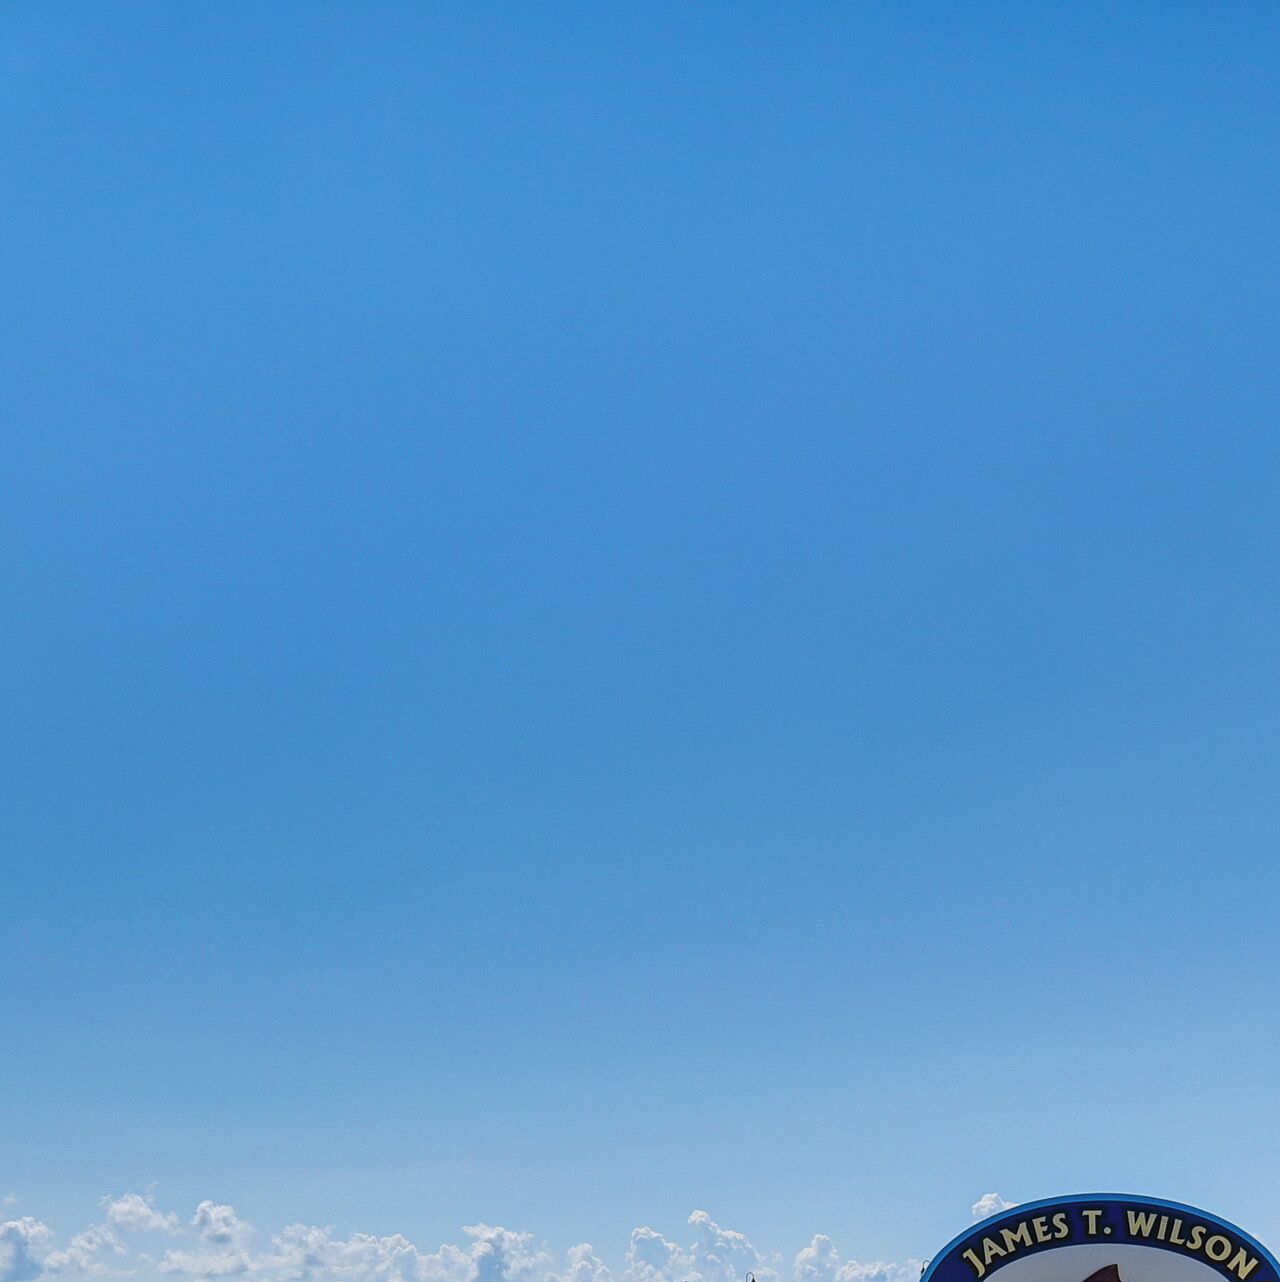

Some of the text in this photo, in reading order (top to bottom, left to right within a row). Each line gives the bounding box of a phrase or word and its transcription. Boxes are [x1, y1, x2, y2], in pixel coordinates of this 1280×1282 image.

[963, 1209, 1260, 1281] JAMES T. WILSON
